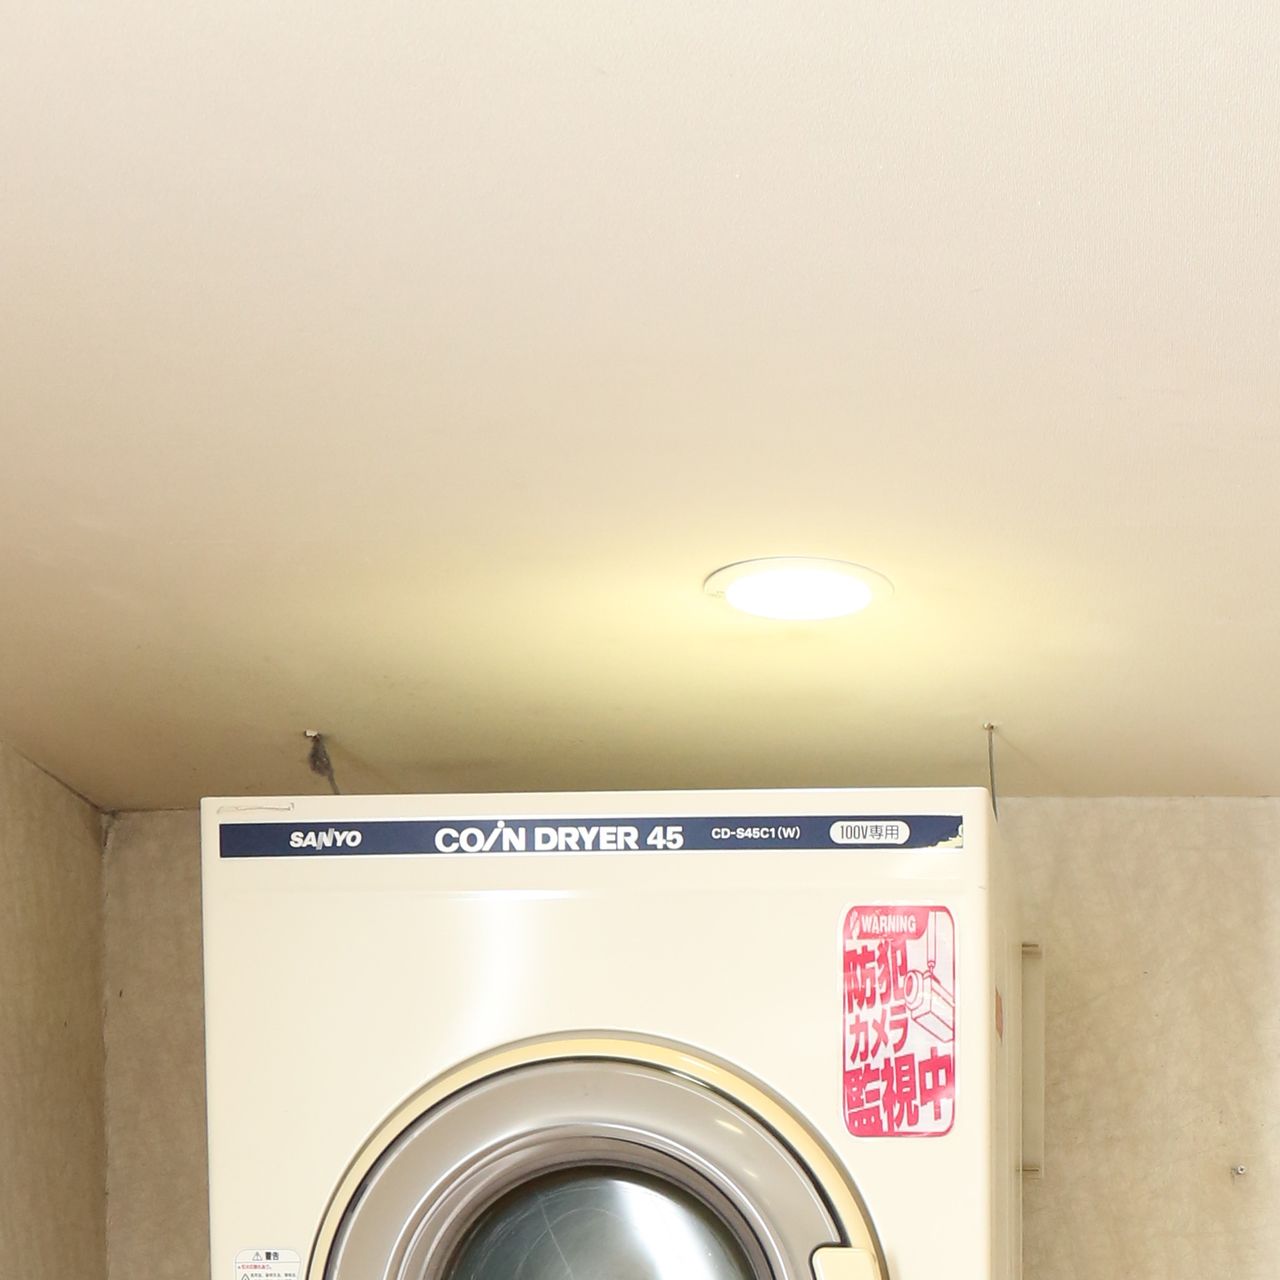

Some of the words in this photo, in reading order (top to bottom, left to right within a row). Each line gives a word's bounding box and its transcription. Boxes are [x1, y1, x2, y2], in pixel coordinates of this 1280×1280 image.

[289, 827, 363, 850] SANYO
[533, 826, 640, 851] DRYER
[646, 826, 685, 850] 45
[711, 825, 801, 840] CD-S45C1(W)
[840, 824, 900, 841] 100V専用
[861, 914, 917, 934] WARNING
[844, 939, 908, 1014] 防犯
[850, 1004, 908, 1064] カメラ
[844, 1046, 952, 1133] 監視中
